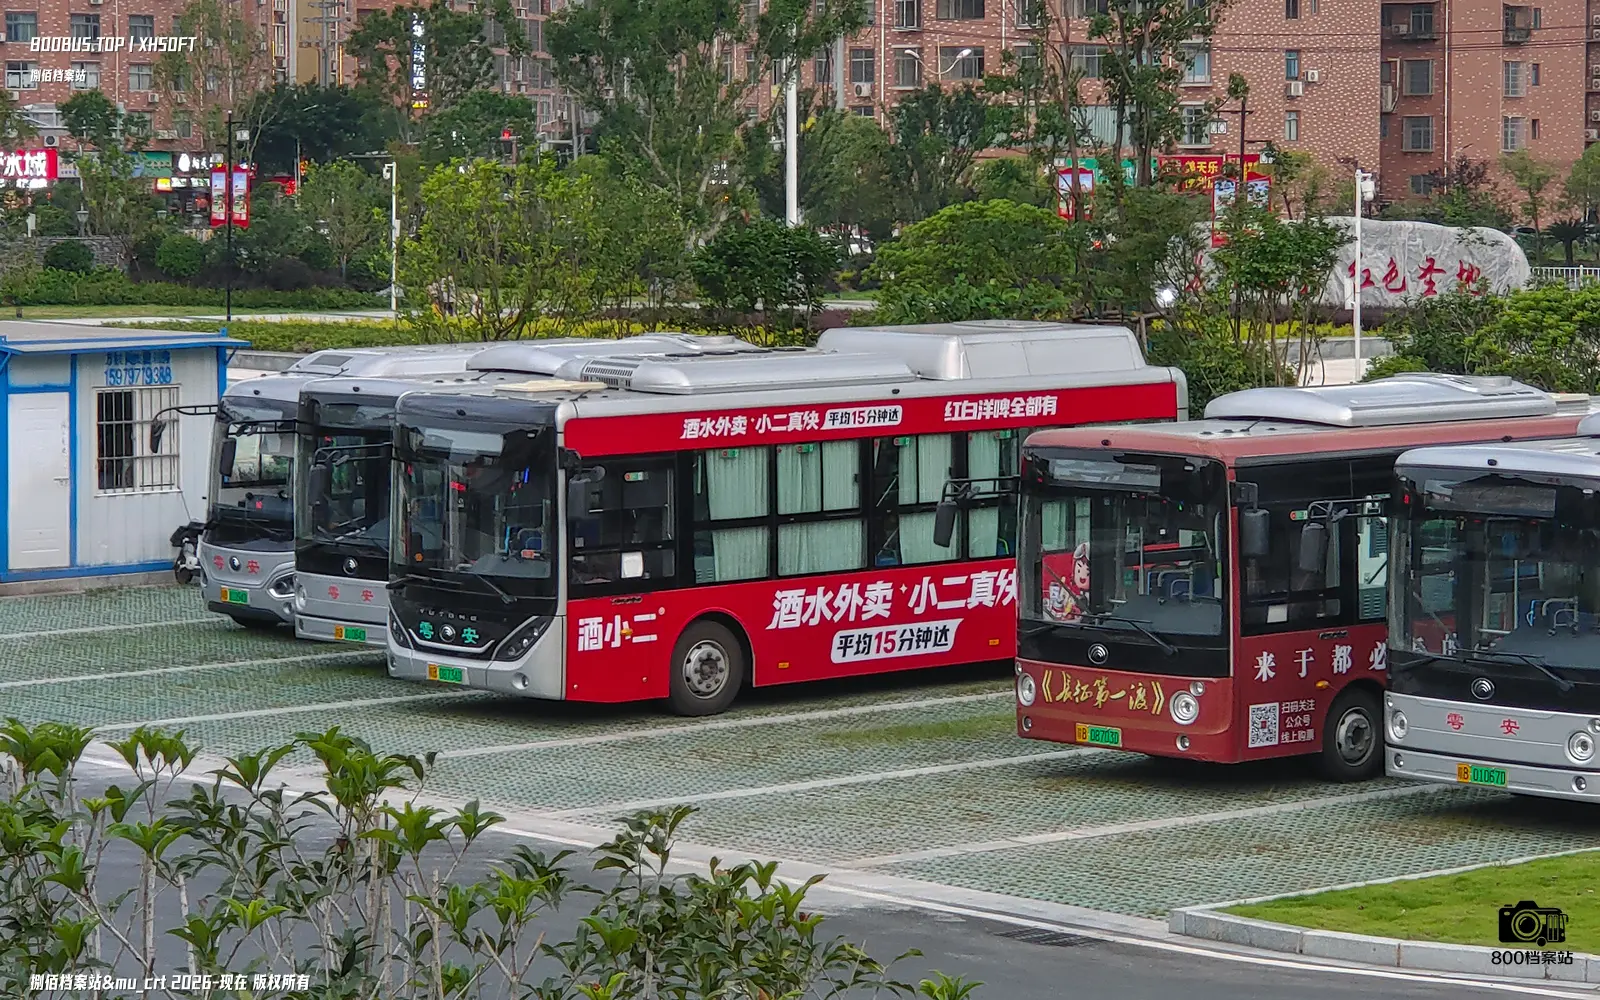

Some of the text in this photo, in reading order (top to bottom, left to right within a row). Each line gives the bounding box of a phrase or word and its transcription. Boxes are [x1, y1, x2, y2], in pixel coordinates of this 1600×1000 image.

[944, 395, 1058, 421] 红白洋啤全都有
[680, 408, 900, 439] 酒水外卖 小二真快 平均15分钟达
[765, 568, 1018, 630] 酒水外卖 小二真快
[419, 608, 478, 621] YUTONG
[577, 613, 658, 652] 酒小二
[837, 624, 950, 658] 平均15分钟达
[1281, 699, 1316, 714] 扫码关注
[1285, 714, 1311, 728] 公众号
[1281, 728, 1315, 744] 线上购票
